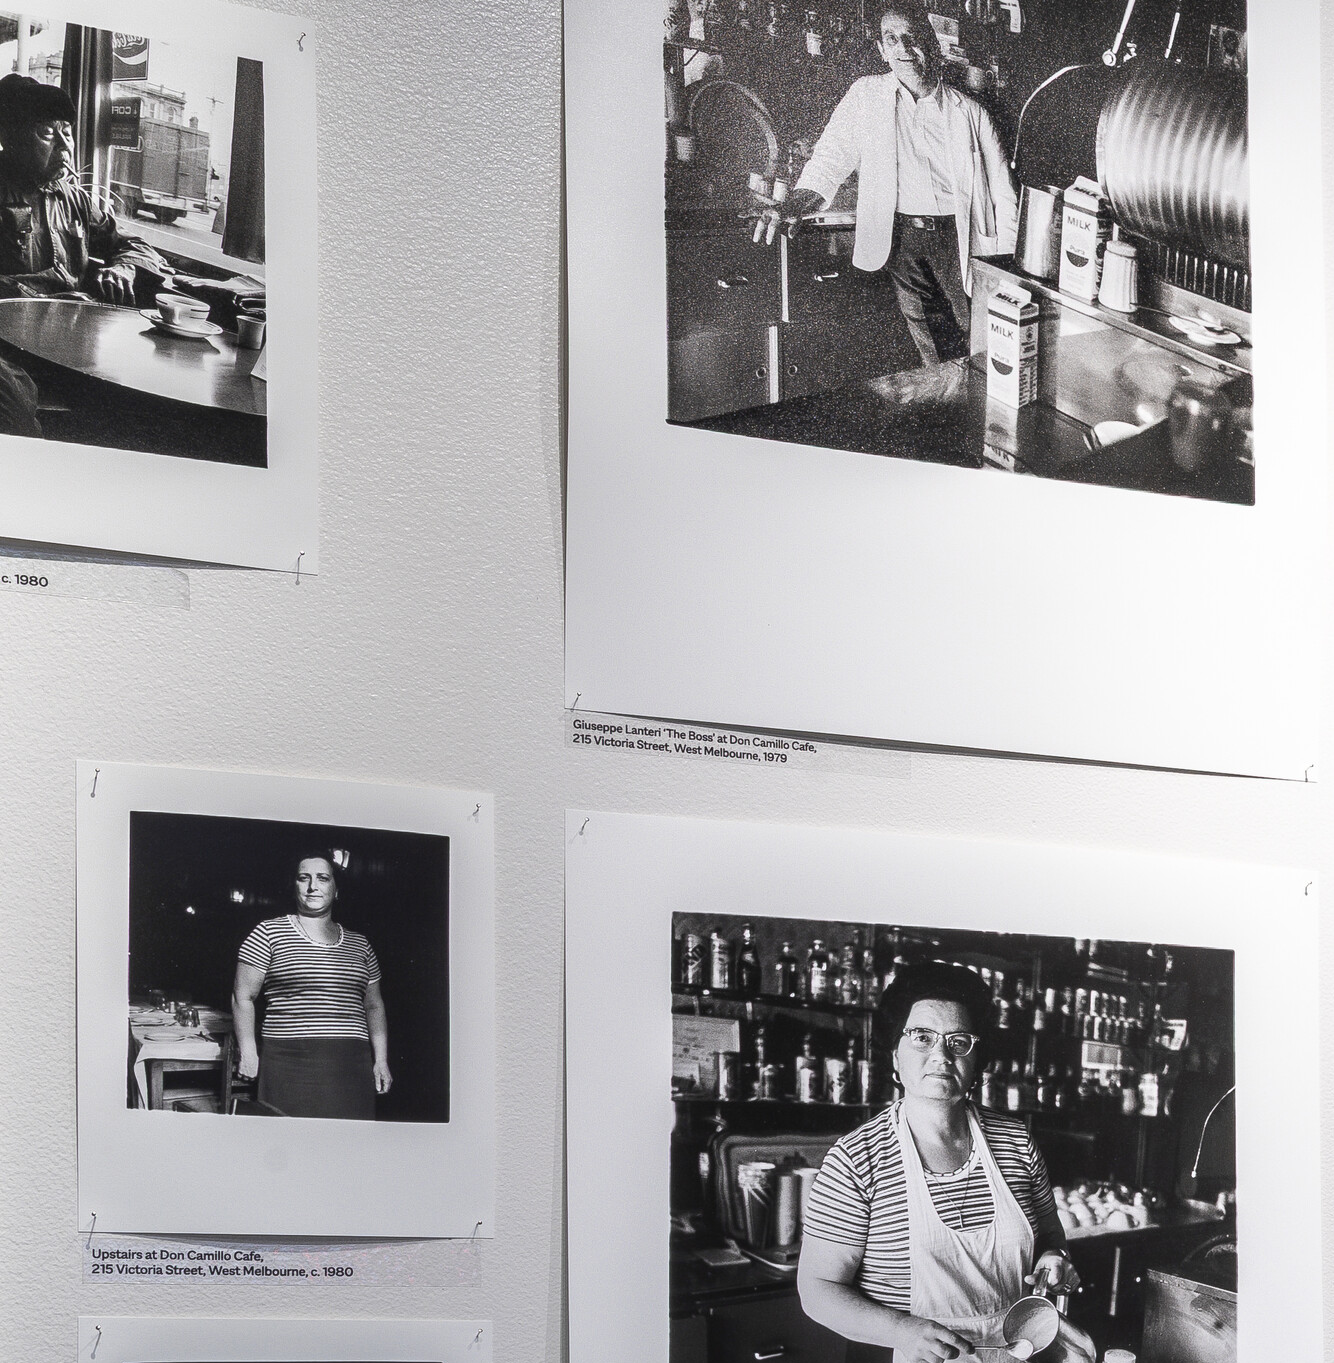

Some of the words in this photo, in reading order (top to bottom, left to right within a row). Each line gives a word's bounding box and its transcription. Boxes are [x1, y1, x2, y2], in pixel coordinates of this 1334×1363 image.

[1067, 215, 1091, 232] MILK
[990, 322, 1014, 340] MILK
[1, 575, 12, 584] c.
[14, 574, 49, 588] 1980
[573, 719, 623, 735] Giuseppe
[625, 724, 662, 738] Lanteri
[716, 734, 728, 744] at
[729, 734, 751, 746] Don
[752, 737, 790, 750] Camillo
[791, 740, 817, 754] Cafe,
[572, 733, 592, 745] 215
[593, 735, 636, 749] Victoria
[636, 739, 672, 754] Street,
[673, 743, 703, 755] West
[704, 745, 761, 762] Melbourne,
[762, 751, 788, 764] 1979
[92, 1248, 143, 1262] Upstairs
[144, 1250, 158, 1260] at
[159, 1249, 185, 1261] Don
[186, 1250, 232, 1261] Camillo
[233, 1250, 264, 1263] Cafe,
[91, 1263, 114, 1275] 215
[115, 1263, 164, 1276] Victoria
[165, 1264, 207, 1277] Street,
[208, 1265, 241, 1276] West
[243, 1265, 309, 1279] Melbourne,
[310, 1269, 321, 1277] c.
[322, 1266, 354, 1277] 1980
